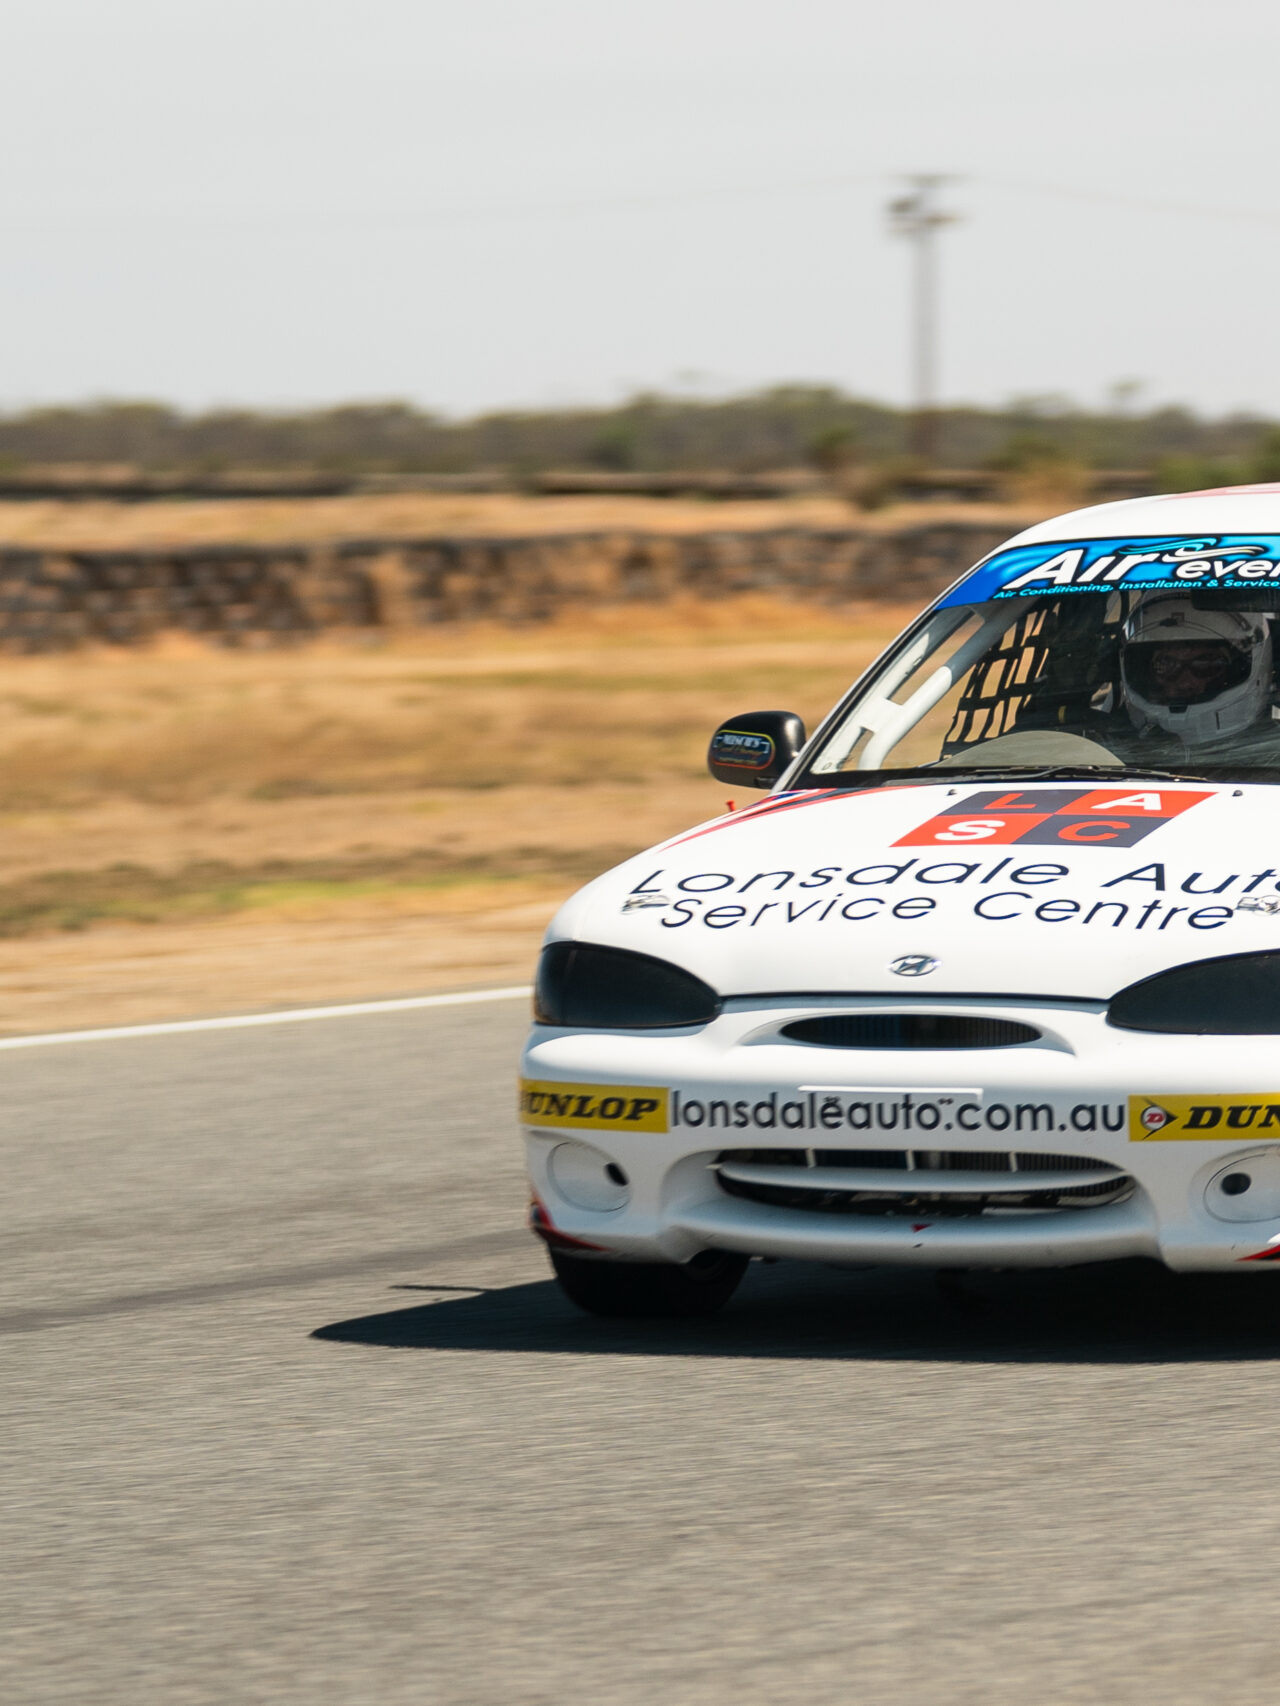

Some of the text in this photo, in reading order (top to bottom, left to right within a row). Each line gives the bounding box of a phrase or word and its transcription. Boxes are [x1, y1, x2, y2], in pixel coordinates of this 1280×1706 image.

[993, 578, 1280, 599] Air Conditioning, Installation & Service
[1002, 549, 1161, 590] Air
[1091, 792, 1162, 811] A
[934, 819, 1131, 842] S C
[630, 856, 1070, 895] Lonsdale
[661, 891, 1234, 930] Service Centre
[671, 1090, 1126, 1132] lonsdaleauto.com.au
